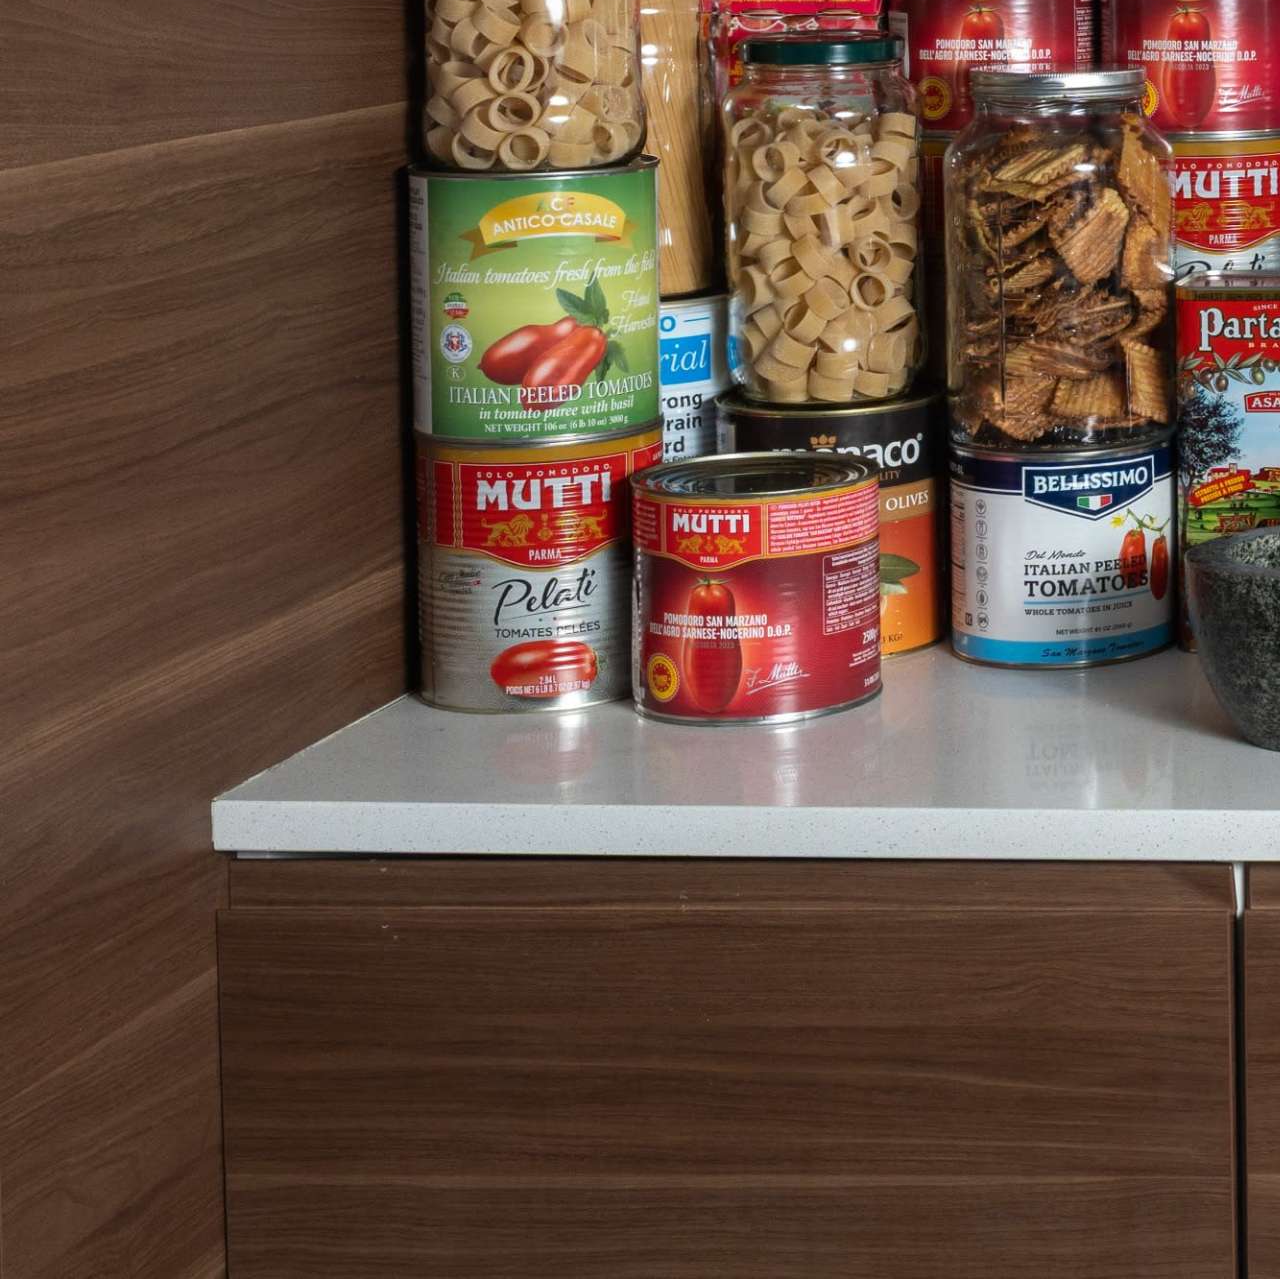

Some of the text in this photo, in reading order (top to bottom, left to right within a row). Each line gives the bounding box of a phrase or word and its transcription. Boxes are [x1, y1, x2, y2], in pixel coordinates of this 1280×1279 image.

[936, 40, 993, 50] POMODORO SAN
[1143, 40, 1237, 50] POMODORO SAN MARZANO
[1170, 168, 1278, 199] MUTTI
[493, 213, 617, 236] ANTICO CASALE
[1209, 234, 1237, 244] PARMA
[435, 261, 480, 284] Italian
[484, 268, 550, 284] tomatoes
[545, 260, 592, 290] fresh
[587, 257, 622, 286] from
[450, 371, 652, 404] ITALIAN PEELED TOMATOES
[479, 395, 634, 422] in tomato puree with basil
[484, 422, 557, 432] NET WEIGHT 106
[477, 471, 513, 479] SOLO
[1033, 467, 1148, 494] BELLISSIMO
[476, 472, 611, 511] MUTTI
[885, 489, 929, 512] OLIVES
[672, 514, 750, 533] MUTTI
[528, 550, 561, 560] PARMA
[1024, 553, 1147, 576] ITALIAN PEELED
[1024, 570, 1148, 598] TOMATOES
[491, 568, 599, 626] Pelati
[1024, 601, 1133, 616] WHOLE TOMATOES IN JUICE
[664, 614, 768, 626] POMODORO SAN MARZANO
[494, 627, 553, 639] TOMATES
[682, 625, 764, 640] SARNESE-NOCERINO
